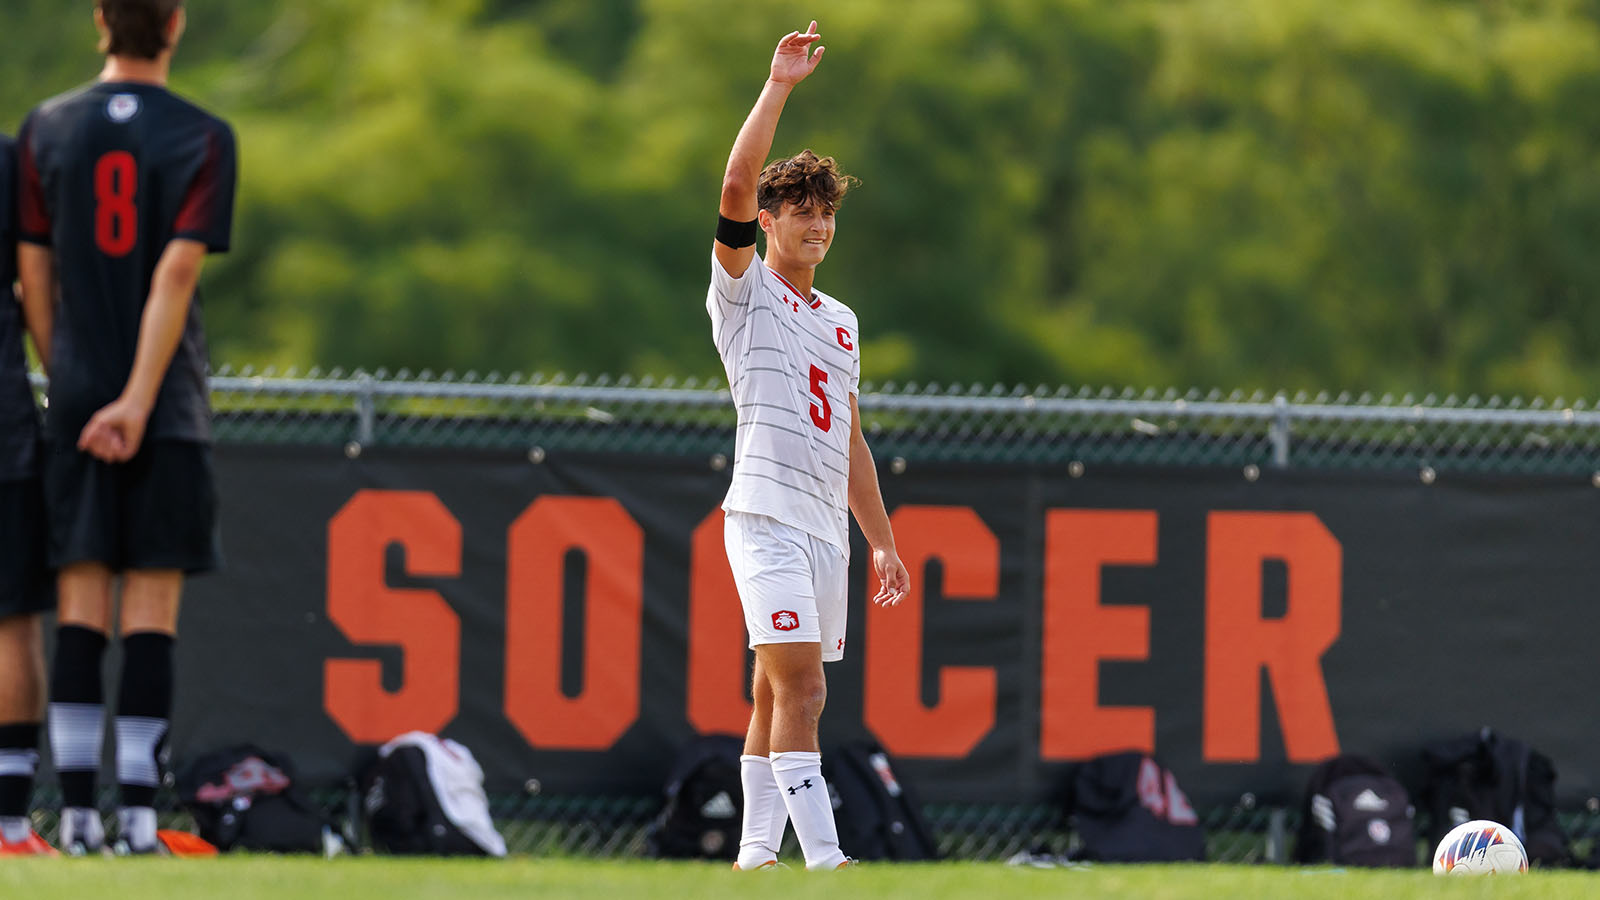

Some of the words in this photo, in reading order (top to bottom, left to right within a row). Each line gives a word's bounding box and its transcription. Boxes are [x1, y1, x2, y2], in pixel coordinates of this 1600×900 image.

[94, 151, 138, 257] 8
[835, 327, 854, 351] C
[809, 363, 832, 433] 5
